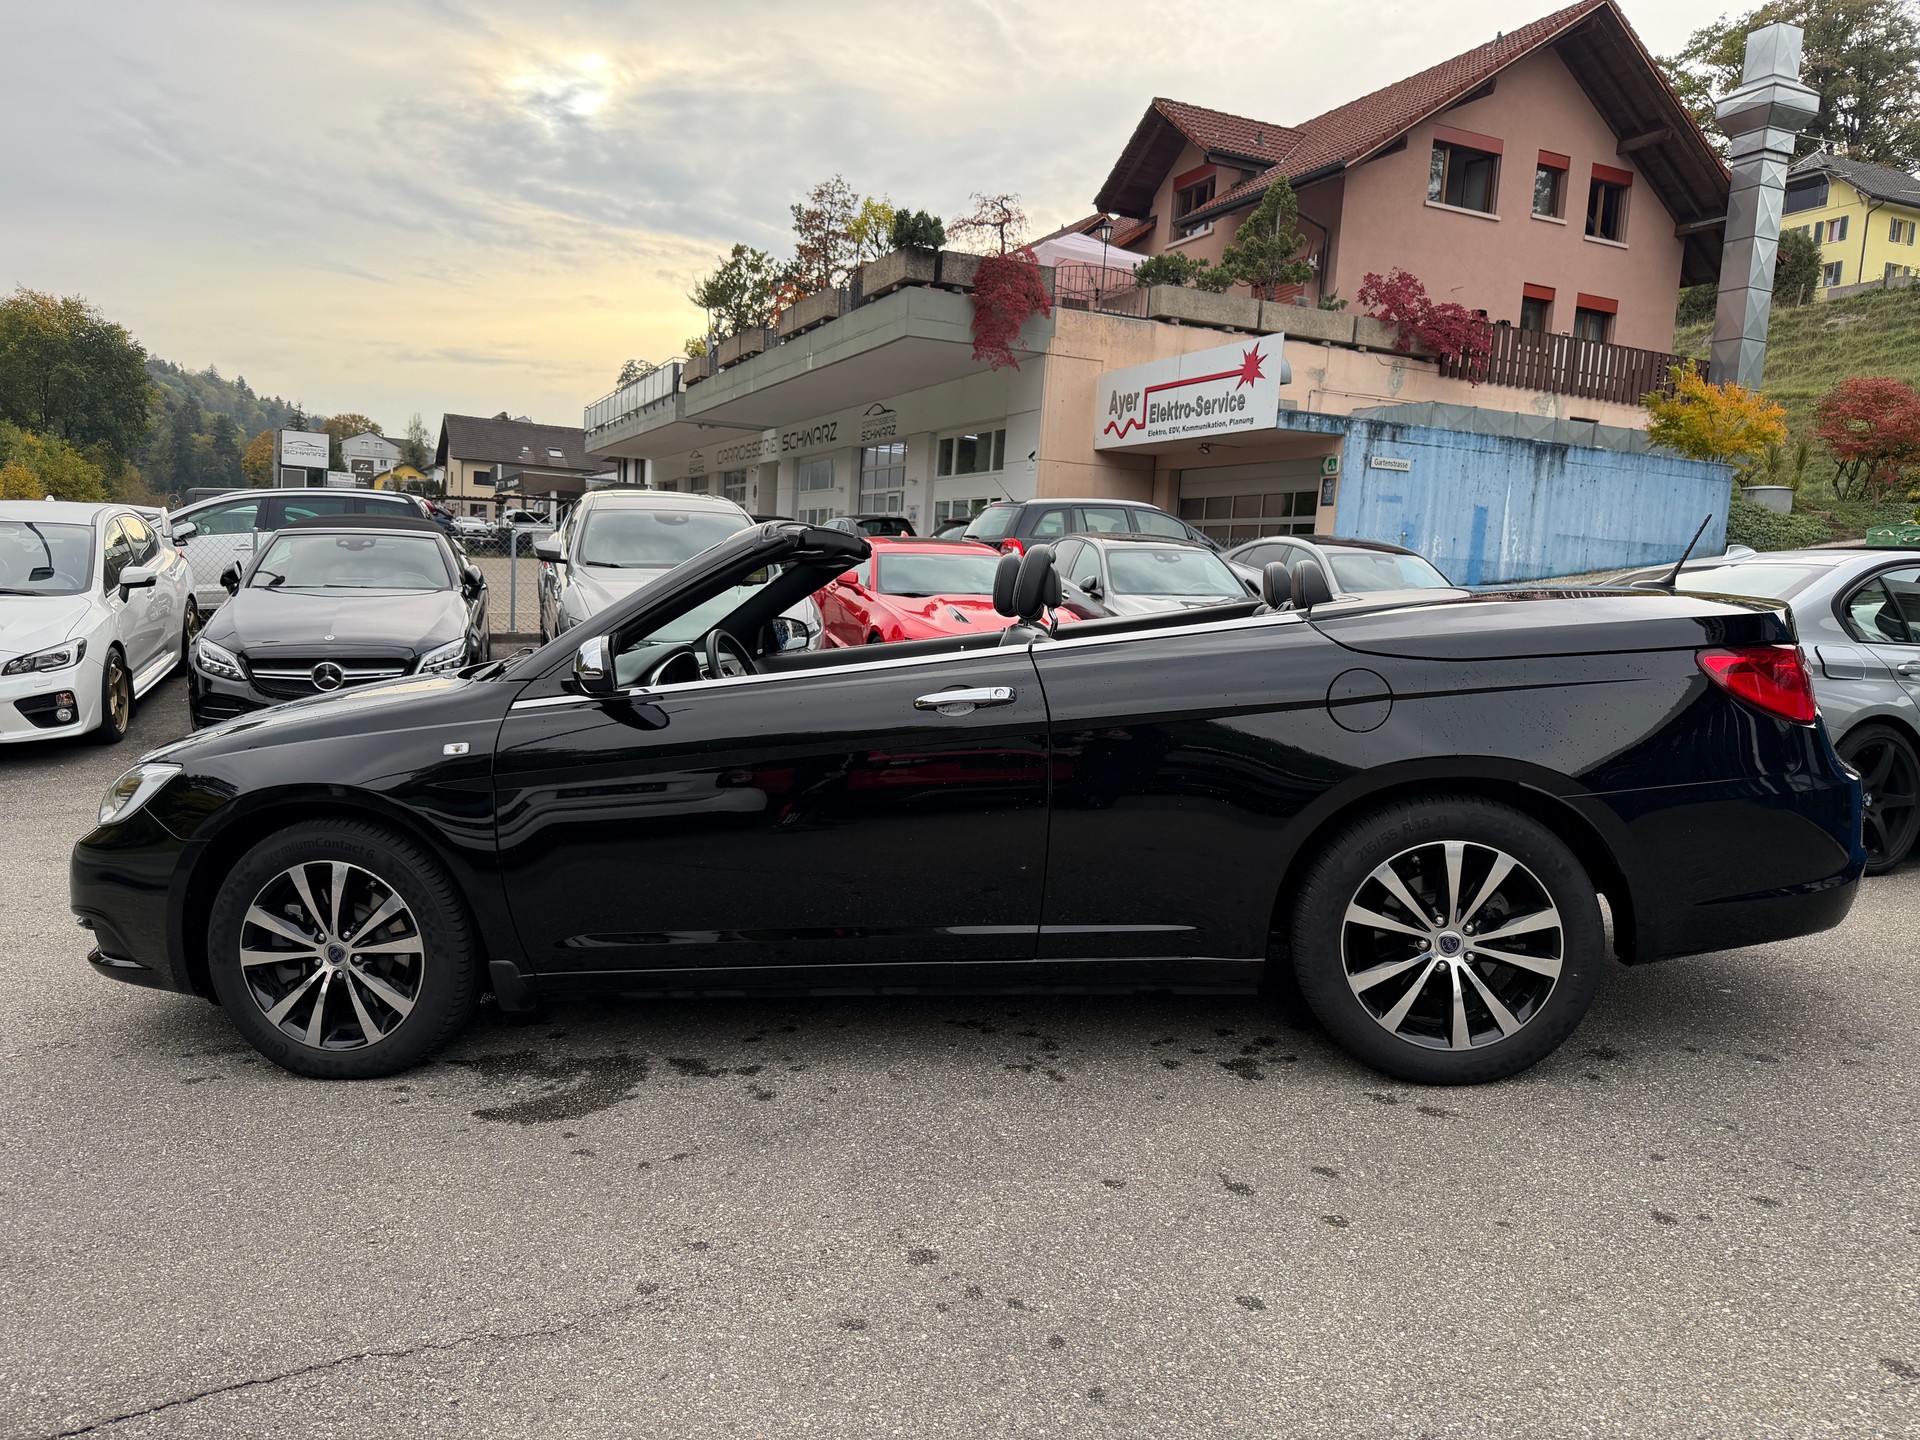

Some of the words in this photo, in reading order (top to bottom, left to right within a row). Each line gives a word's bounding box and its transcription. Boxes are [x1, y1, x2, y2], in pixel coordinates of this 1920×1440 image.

[1109, 390, 1140, 420] Ayer
[1149, 391, 1246, 424] Elektro-Service
[861, 424, 897, 441] SCHWARZ
[1147, 428, 1167, 437] Elektro,
[1168, 426, 1181, 434] EDV,
[1181, 421, 1228, 433] Kommunikation,
[1229, 416, 1254, 426] Planung
[717, 436, 778, 465] CARROSSERIE
[782, 421, 838, 452] SCHWARZ
[1374, 458, 1409, 469] Gartenstrasse
[366, 849, 376, 860] 6
